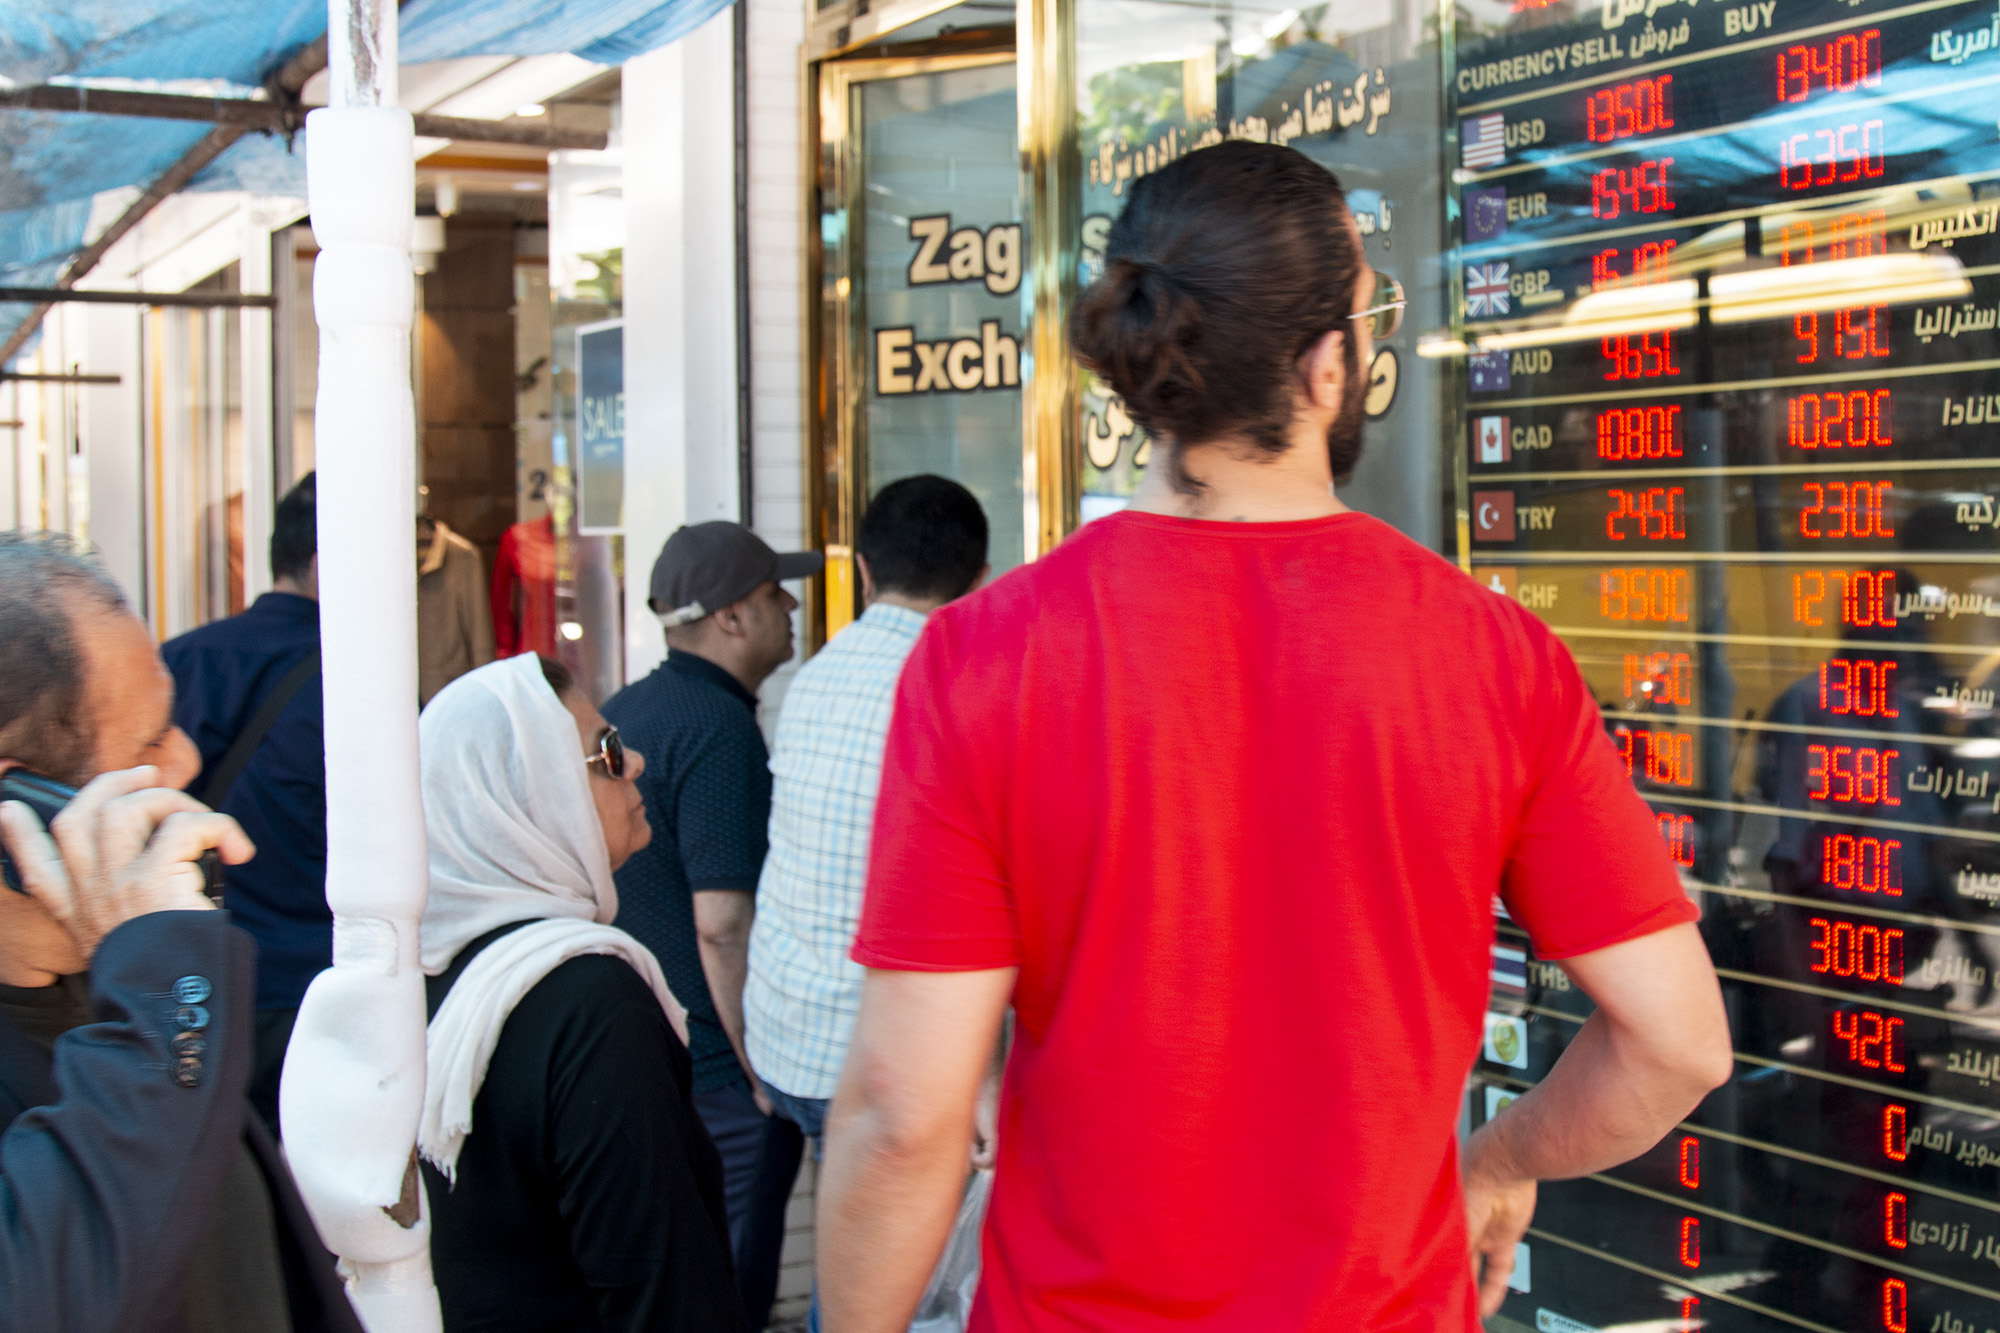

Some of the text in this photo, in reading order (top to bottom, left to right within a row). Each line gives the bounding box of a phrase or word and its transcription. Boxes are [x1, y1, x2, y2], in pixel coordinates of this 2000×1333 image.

[1724, 1, 1777, 37] BUY
[1629, 17, 1690, 59] فروش
[1458, 34, 1624, 93] CURRENCY SELL
[1504, 118, 1546, 148] USD
[1506, 191, 1549, 221] EUR
[1509, 270, 1550, 297] GBP
[1511, 349, 1553, 376] AUD
[1511, 424, 1553, 450] CAD
[1517, 506, 1556, 530] TRY
[1519, 583, 1559, 609] CHF
[1908, 765, 1989, 799] امارات
[1527, 959, 1570, 992] THB
[1884, 1104, 1906, 1161] 0
[1909, 1220, 1970, 1253] آزادی
[1882, 1277, 1907, 1333] 0
